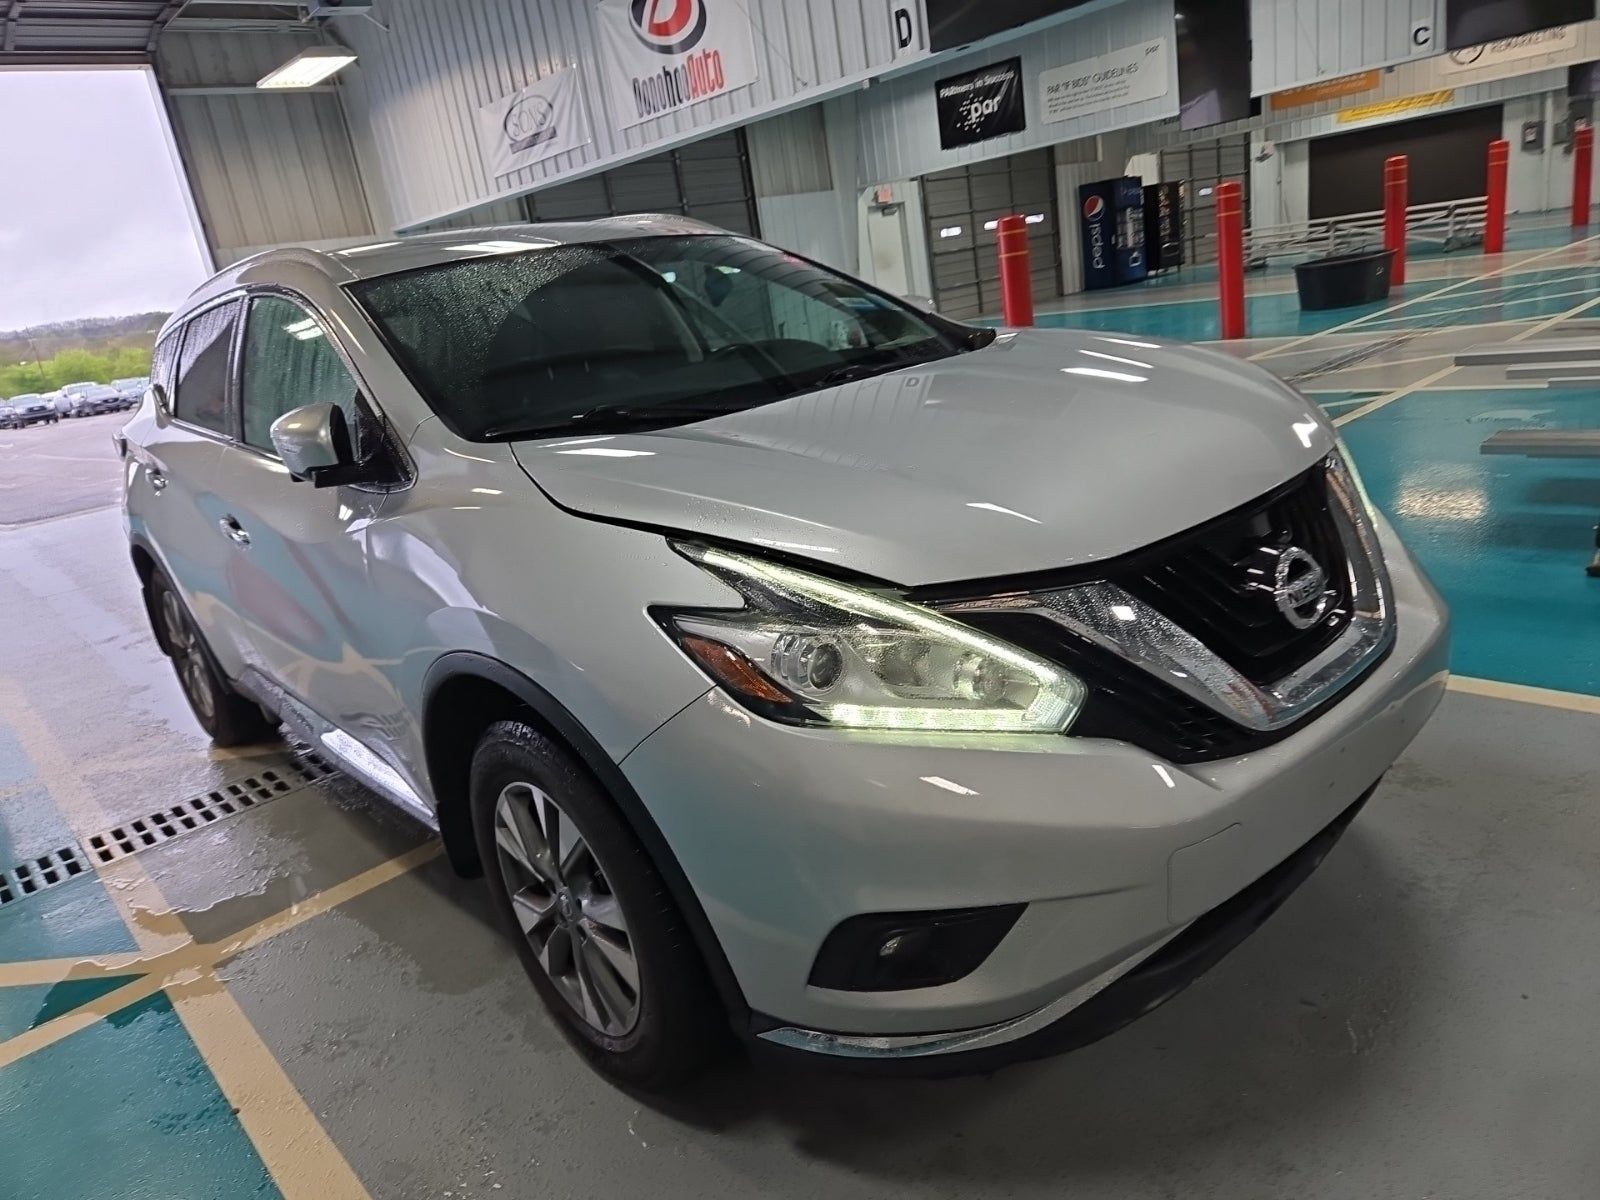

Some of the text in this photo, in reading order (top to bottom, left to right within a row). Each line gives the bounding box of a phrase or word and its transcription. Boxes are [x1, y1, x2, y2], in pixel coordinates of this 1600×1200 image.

[894, 8, 913, 49] D
[1413, 26, 1430, 46] C
[970, 96, 1001, 124] par
